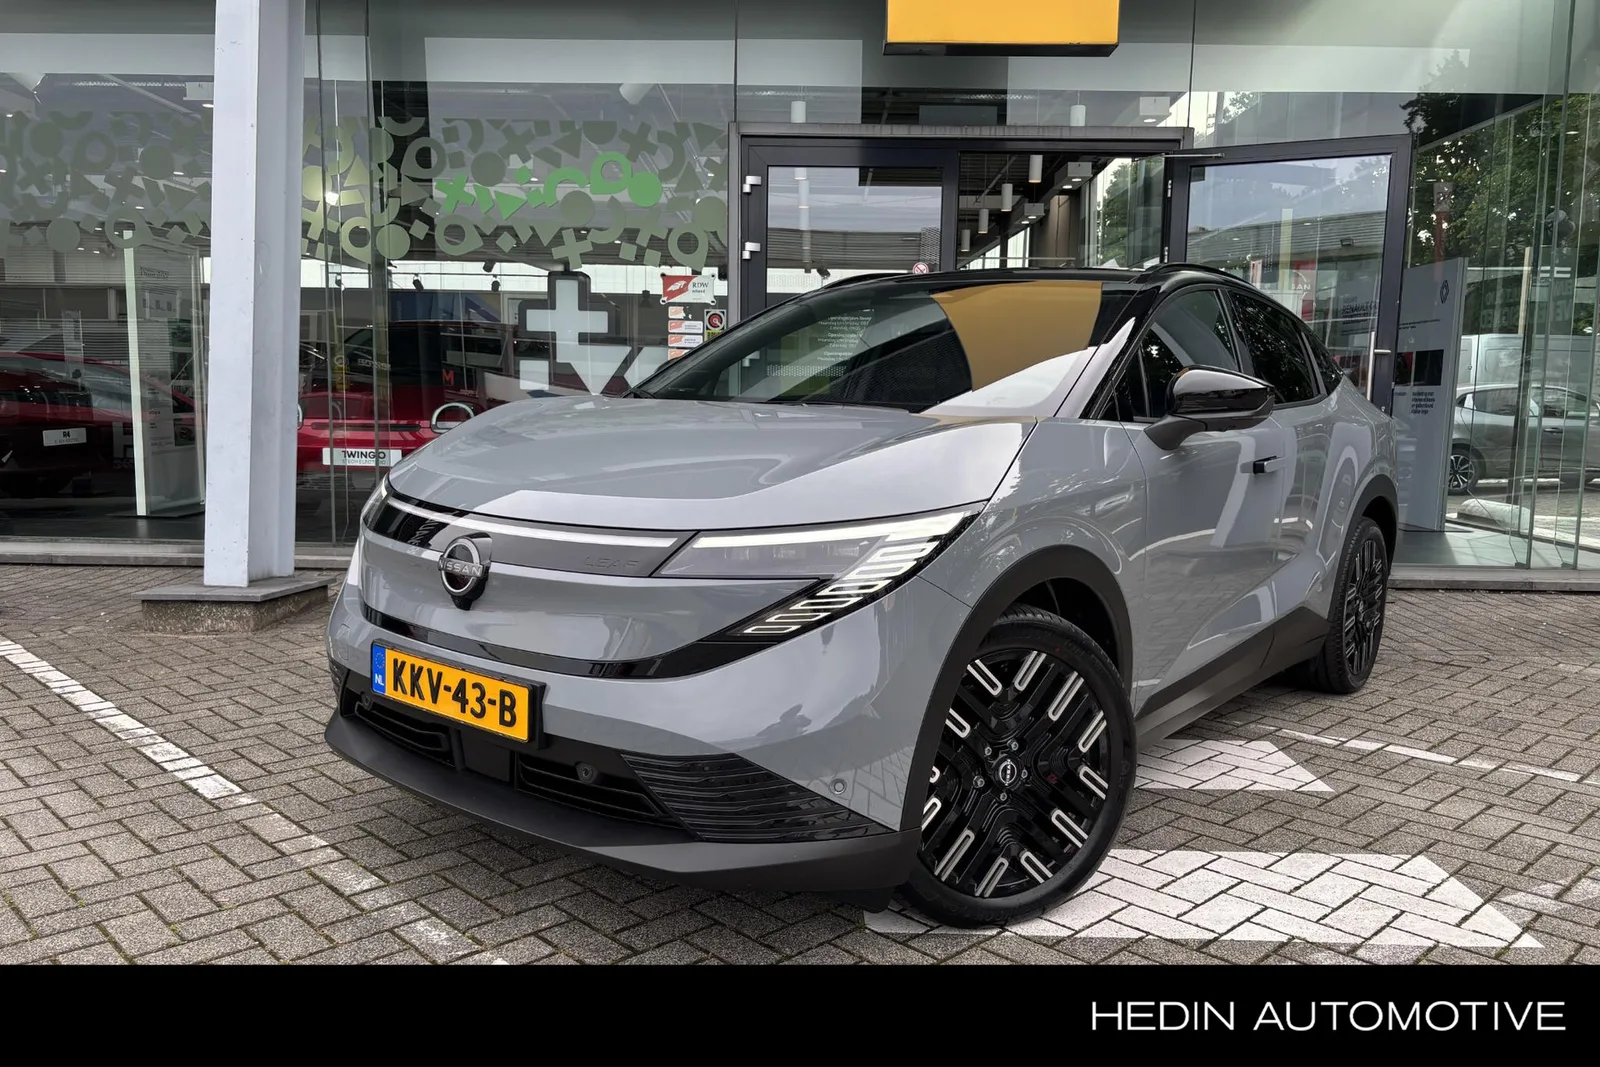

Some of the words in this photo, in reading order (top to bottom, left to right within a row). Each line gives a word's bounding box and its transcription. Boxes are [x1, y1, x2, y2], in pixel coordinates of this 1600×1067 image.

[342, 450, 386, 459] TWINGO
[439, 559, 481, 577] NISSAN
[374, 673, 385, 687] NL
[392, 657, 517, 728] KKV-43-B
